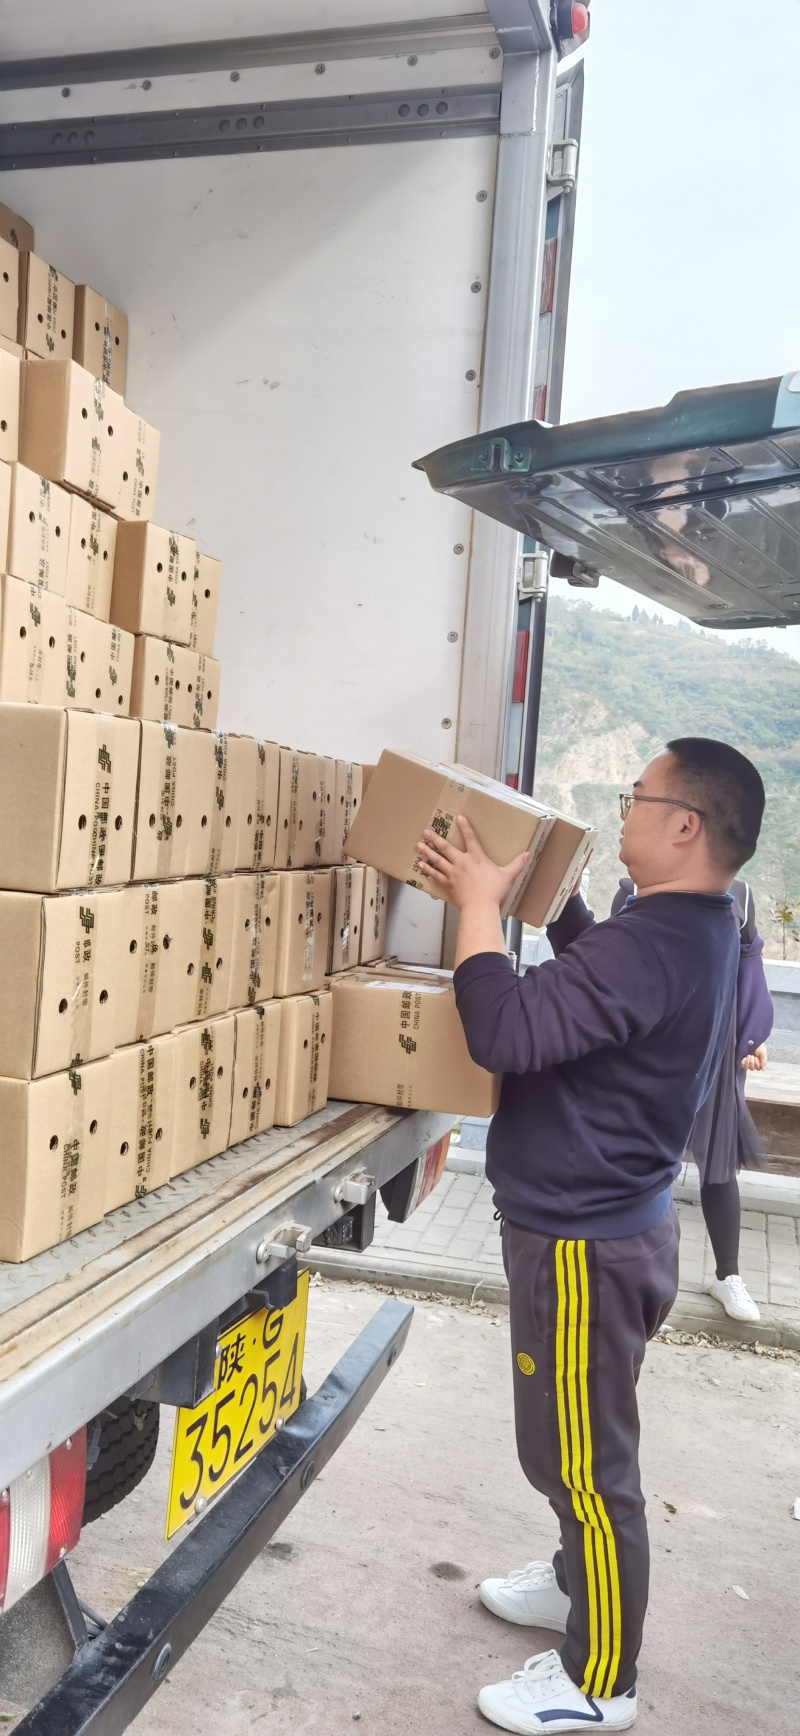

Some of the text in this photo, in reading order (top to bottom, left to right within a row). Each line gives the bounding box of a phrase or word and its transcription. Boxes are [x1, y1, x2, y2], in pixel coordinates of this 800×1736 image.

[400, 991, 412, 1029] 中国邮政
[414, 992, 422, 1009] POST
[146, 1045, 155, 1095] 中国邮政
[62, 1143, 70, 1176] CHINA
[68, 1138, 81, 1196] 中国邮政
[136, 1124, 147, 1177] 中国邮政
[179, 1331, 300, 1511] 35254
